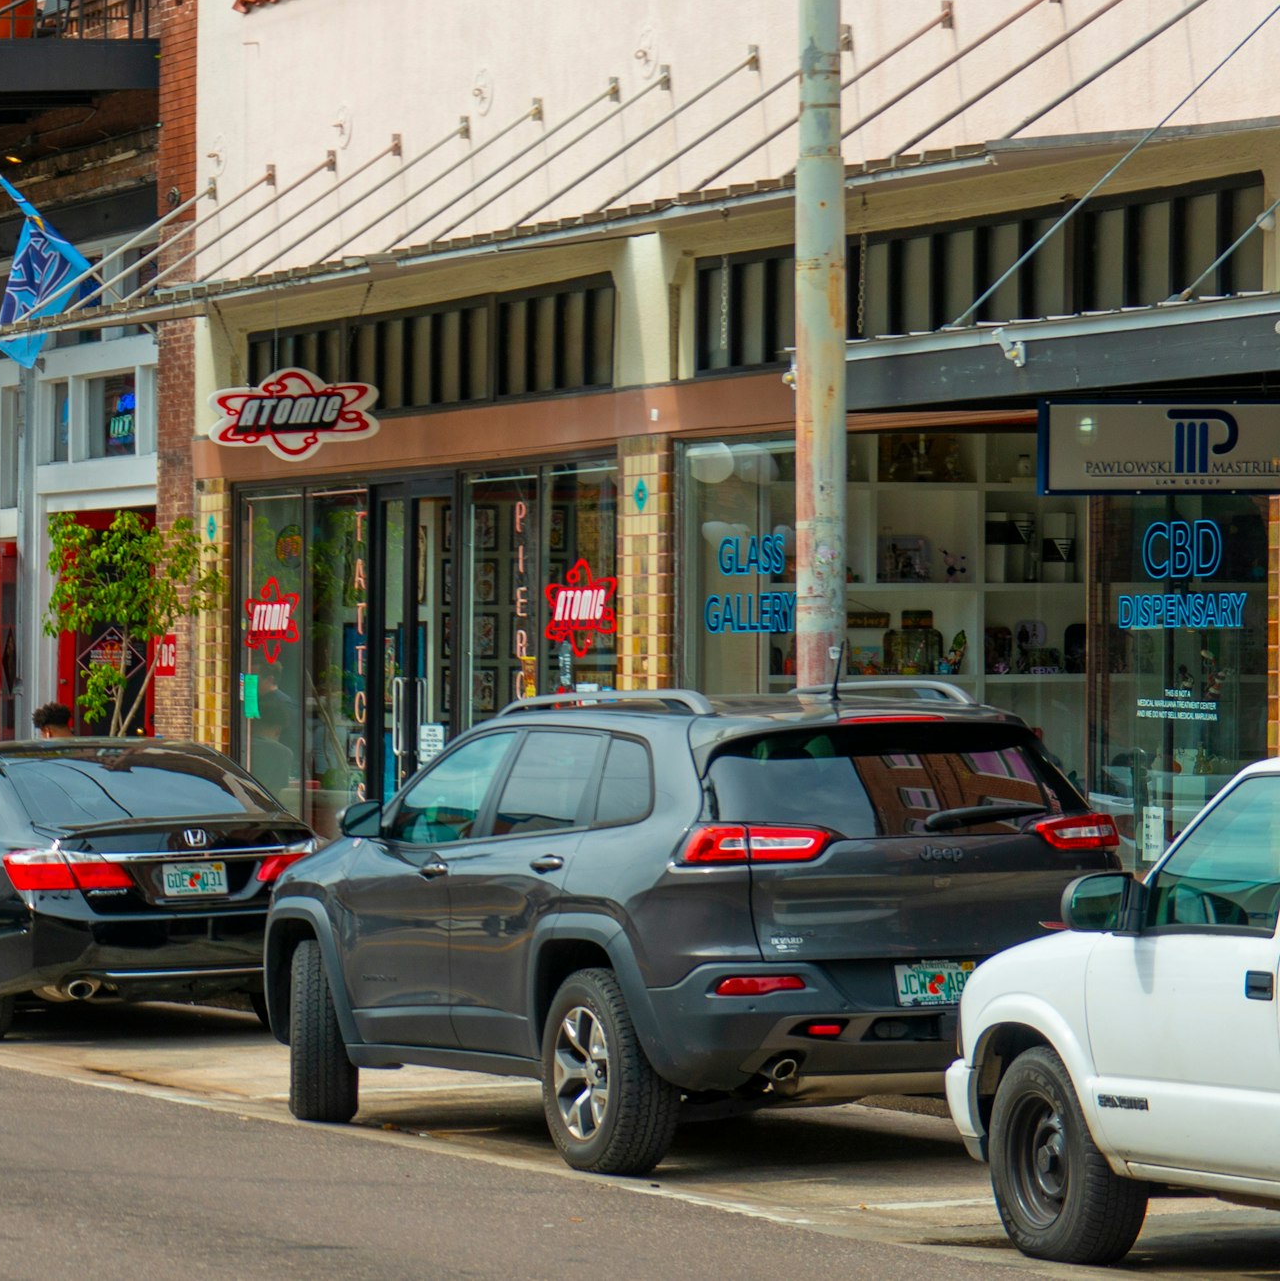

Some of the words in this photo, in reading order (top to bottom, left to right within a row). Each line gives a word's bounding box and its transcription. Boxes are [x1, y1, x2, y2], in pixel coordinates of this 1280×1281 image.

[237, 395, 343, 431] ATOMIC
[1085, 461, 1172, 474] PAWLOWSKI
[1184, 478, 1221, 486] GROUP
[718, 534, 785, 576] GLASS
[1142, 520, 1222, 579] CBD
[252, 602, 290, 632] ATOMIC
[555, 589, 606, 622] ATOMIC
[704, 591, 797, 634] GALLERY
[1118, 593, 1248, 629] DISPENSARY
[1137, 699, 1154, 707] MEDICAL
[1154, 700, 1176, 708] MARIJUANA
[1177, 701, 1200, 709] TREATMENT
[1200, 702, 1216, 710] CENTER
[1164, 689, 1174, 697] THIS
[1179, 689, 1187, 697] NOT
[1136, 710, 1145, 718] AND
[1146, 710, 1152, 718] WE
[1152, 710, 1159, 718] DO
[1159, 710, 1167, 718] NOT
[1168, 711, 1177, 719] SELL
[1177, 711, 1194, 720] MEDICAL
[1195, 712, 1218, 721] MARIJUANA
[919, 845, 964, 863] Jeep
